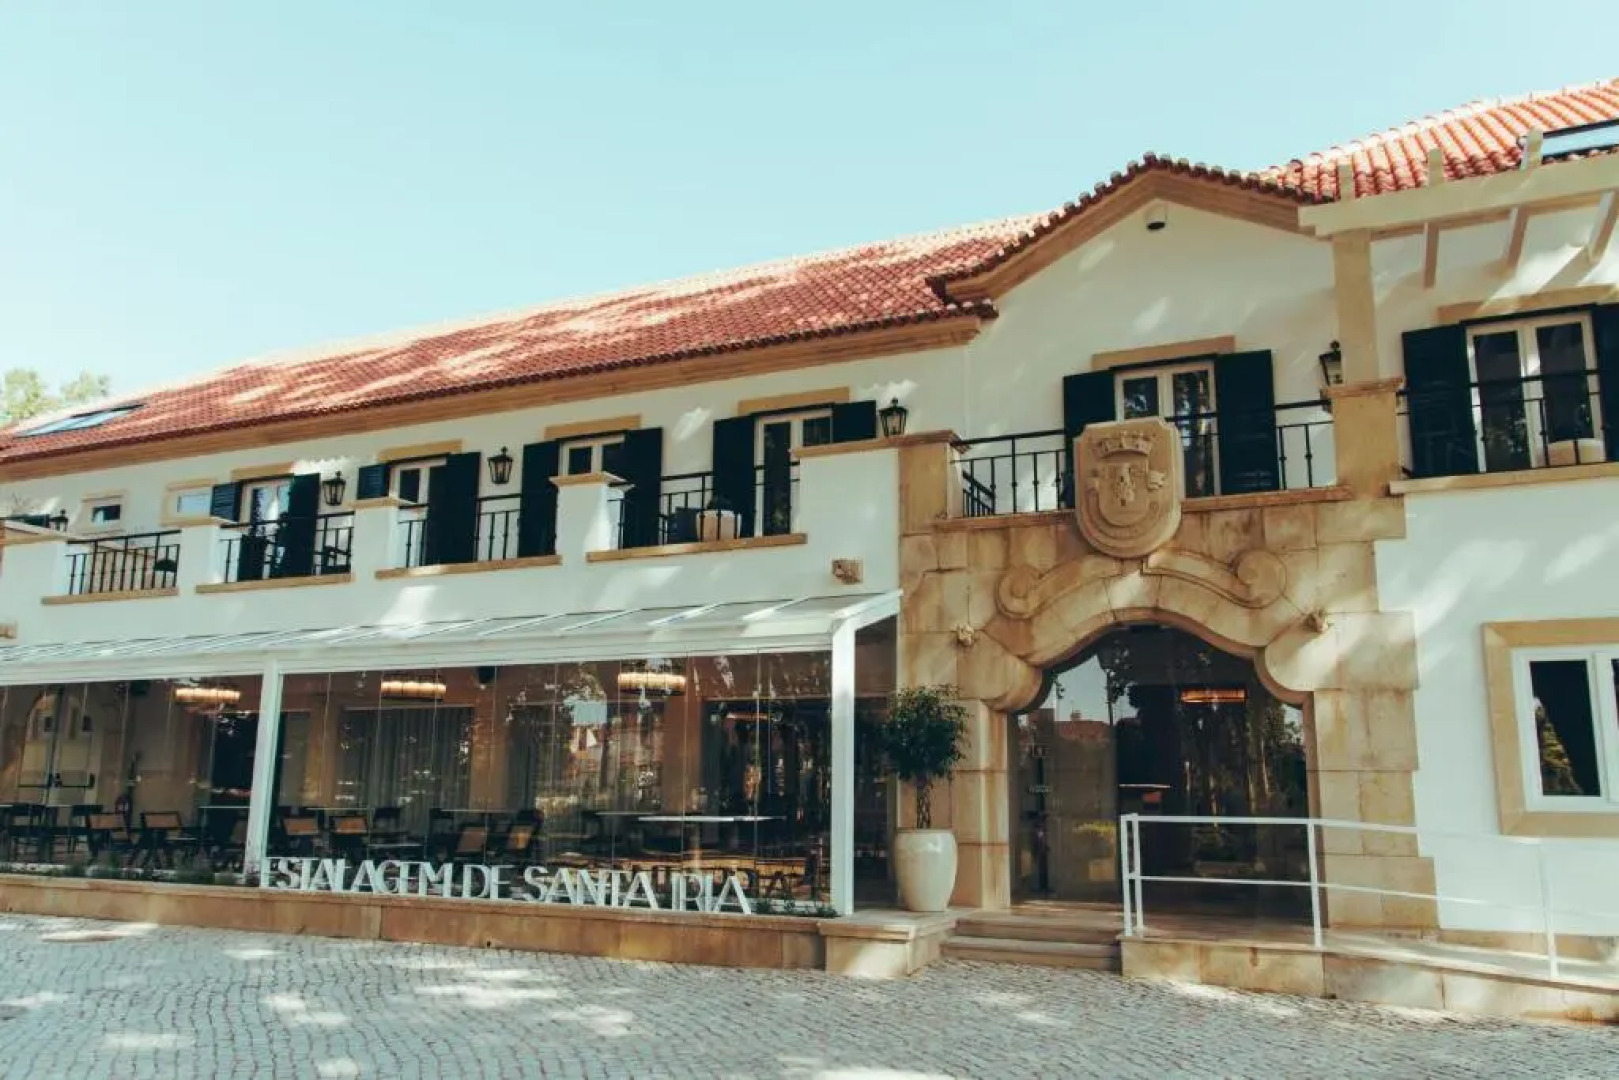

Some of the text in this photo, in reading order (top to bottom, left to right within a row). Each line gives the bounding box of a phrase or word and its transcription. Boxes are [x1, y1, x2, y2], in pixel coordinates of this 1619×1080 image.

[259, 857, 752, 914] ESTALAGEM DE SANTA IRIA
